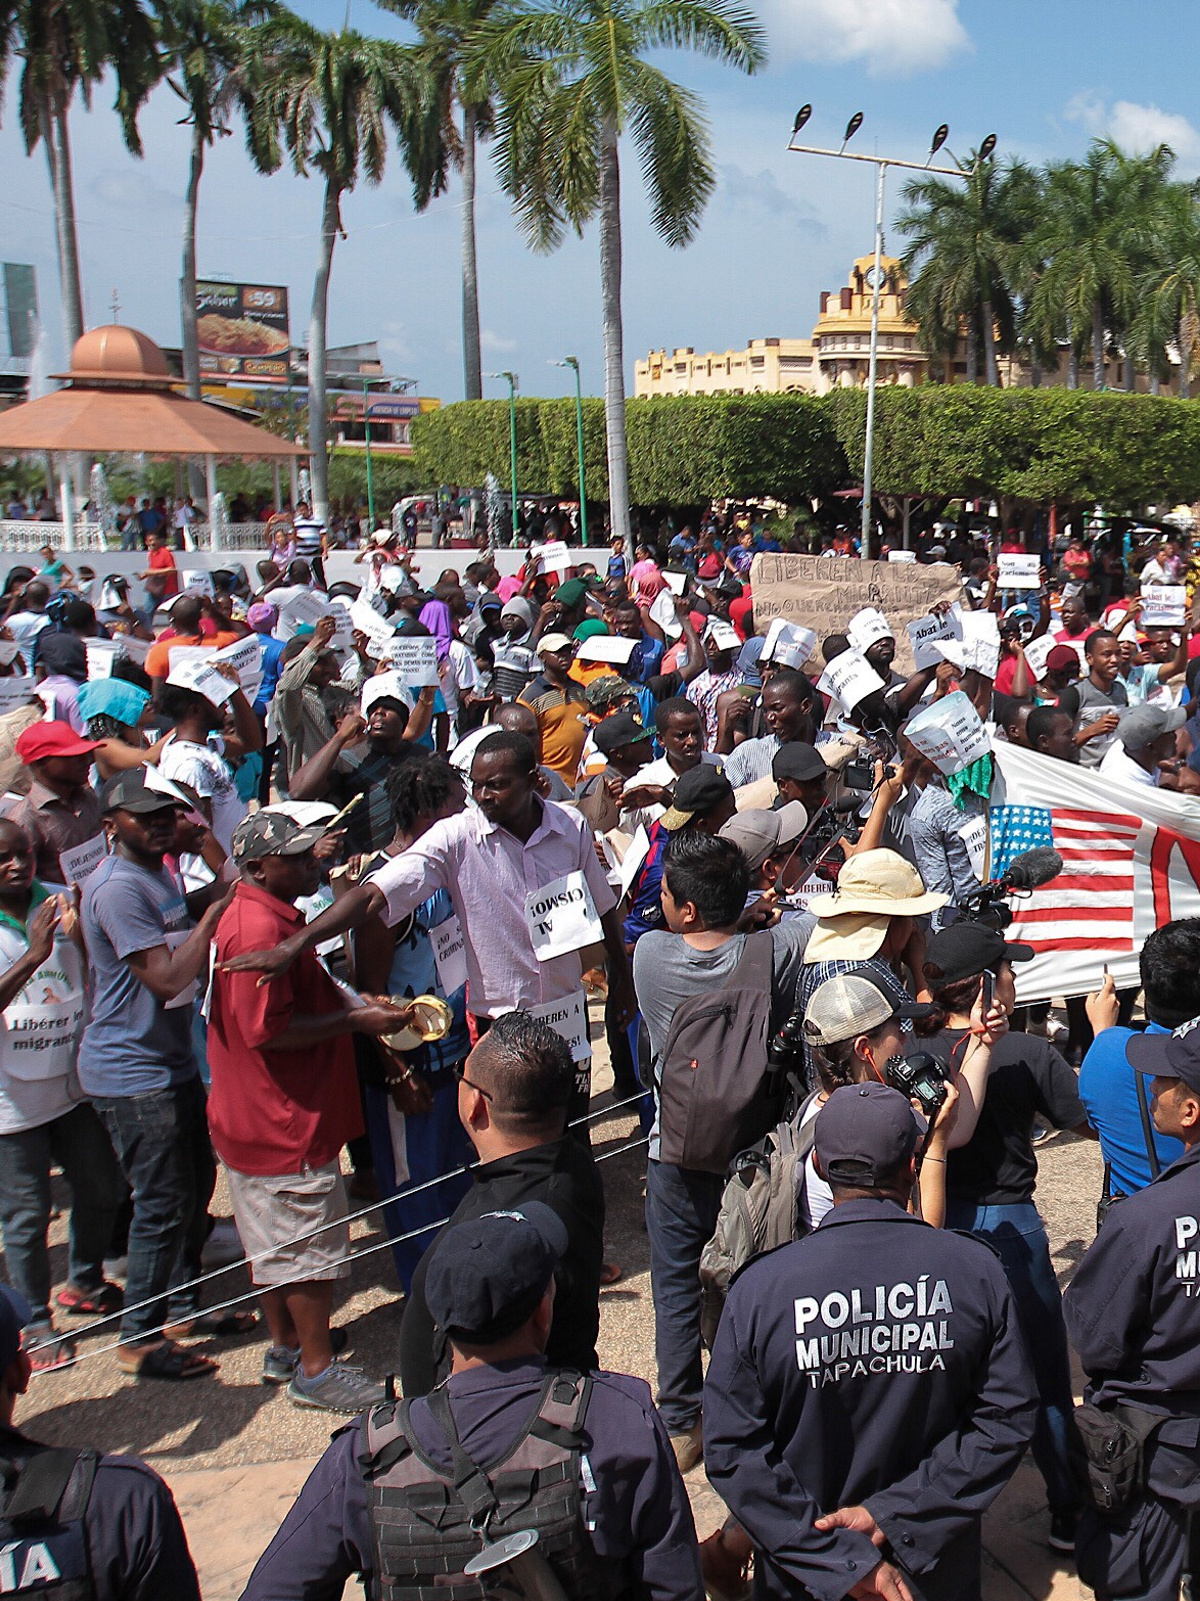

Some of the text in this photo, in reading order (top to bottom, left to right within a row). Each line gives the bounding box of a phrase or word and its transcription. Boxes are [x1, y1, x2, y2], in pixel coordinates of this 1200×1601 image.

[757, 555, 864, 584] LIBEREN
[916, 625, 937, 639] Abat
[574, 1004, 580, 1015] A
[13, 1018, 69, 1031] Libérer
[13, 1032, 76, 1052] migrants
[794, 1275, 954, 1335] POLICÍA
[795, 1320, 955, 1371] MUNICIPAL
[805, 1354, 946, 1389] TAPACHULA
